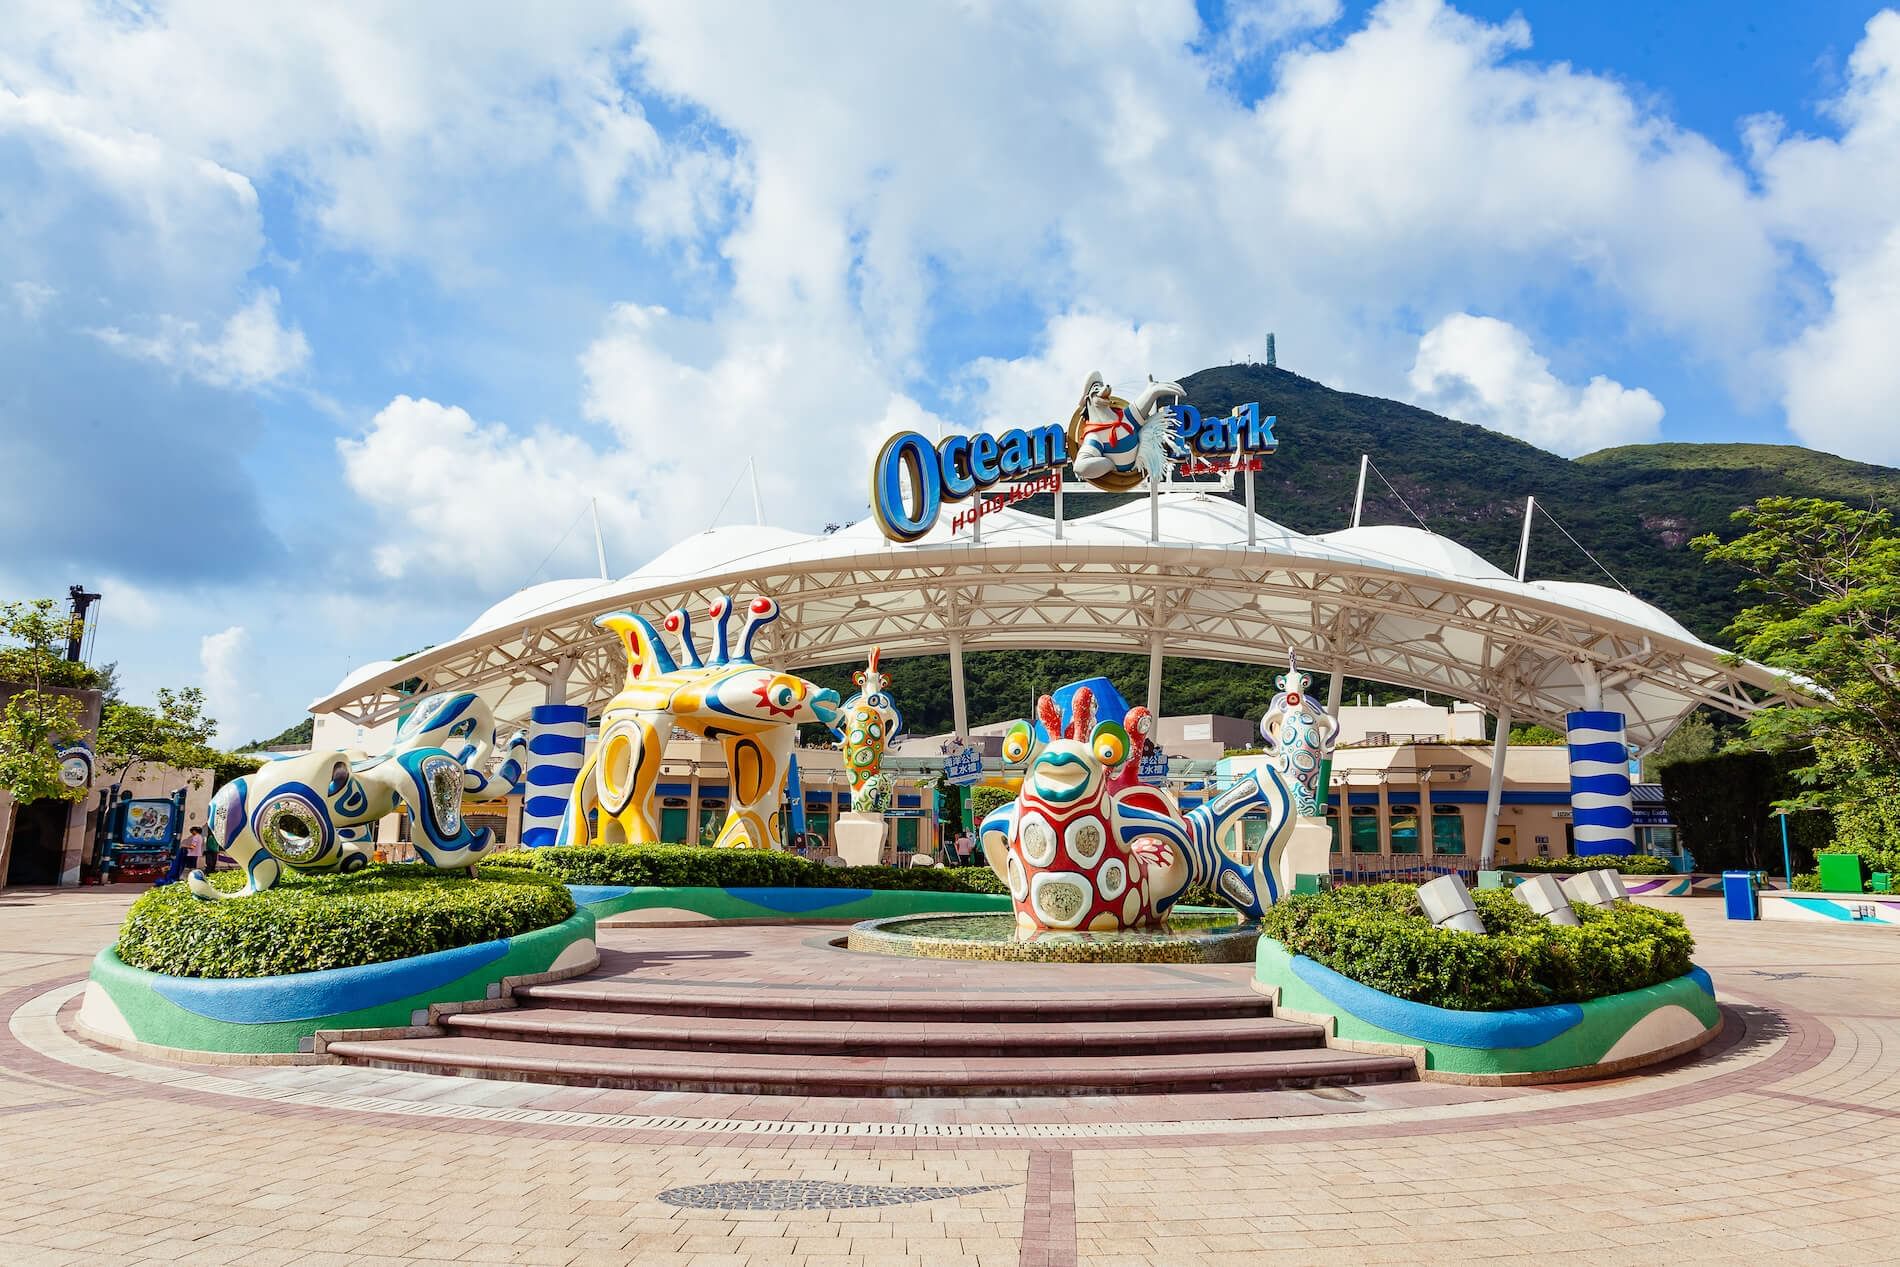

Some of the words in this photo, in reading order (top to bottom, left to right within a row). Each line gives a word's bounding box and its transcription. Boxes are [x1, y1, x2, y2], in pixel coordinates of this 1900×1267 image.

[873, 424, 1066, 542] Ocean
[1160, 402, 1278, 456] Park
[952, 493, 1005, 535] Hong
[1009, 472, 1061, 504] Kong
